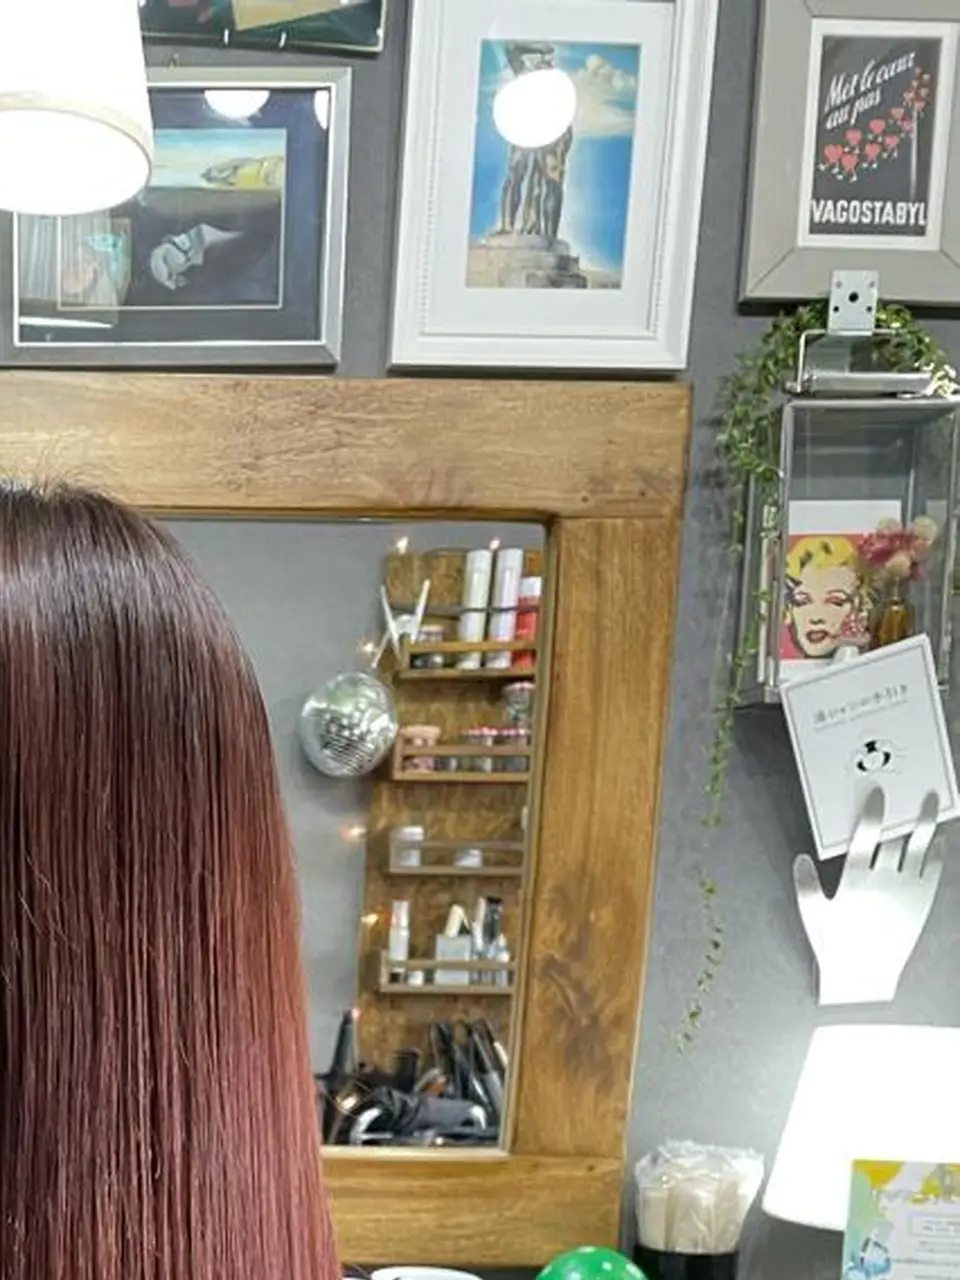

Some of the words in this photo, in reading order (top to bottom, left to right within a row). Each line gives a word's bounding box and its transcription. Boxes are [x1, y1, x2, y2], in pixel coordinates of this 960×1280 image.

[824, 73, 859, 113] Met
[860, 59, 875, 91] le
[850, 87, 881, 125] pas
[812, 199, 927, 225] VAGOSTABYL
